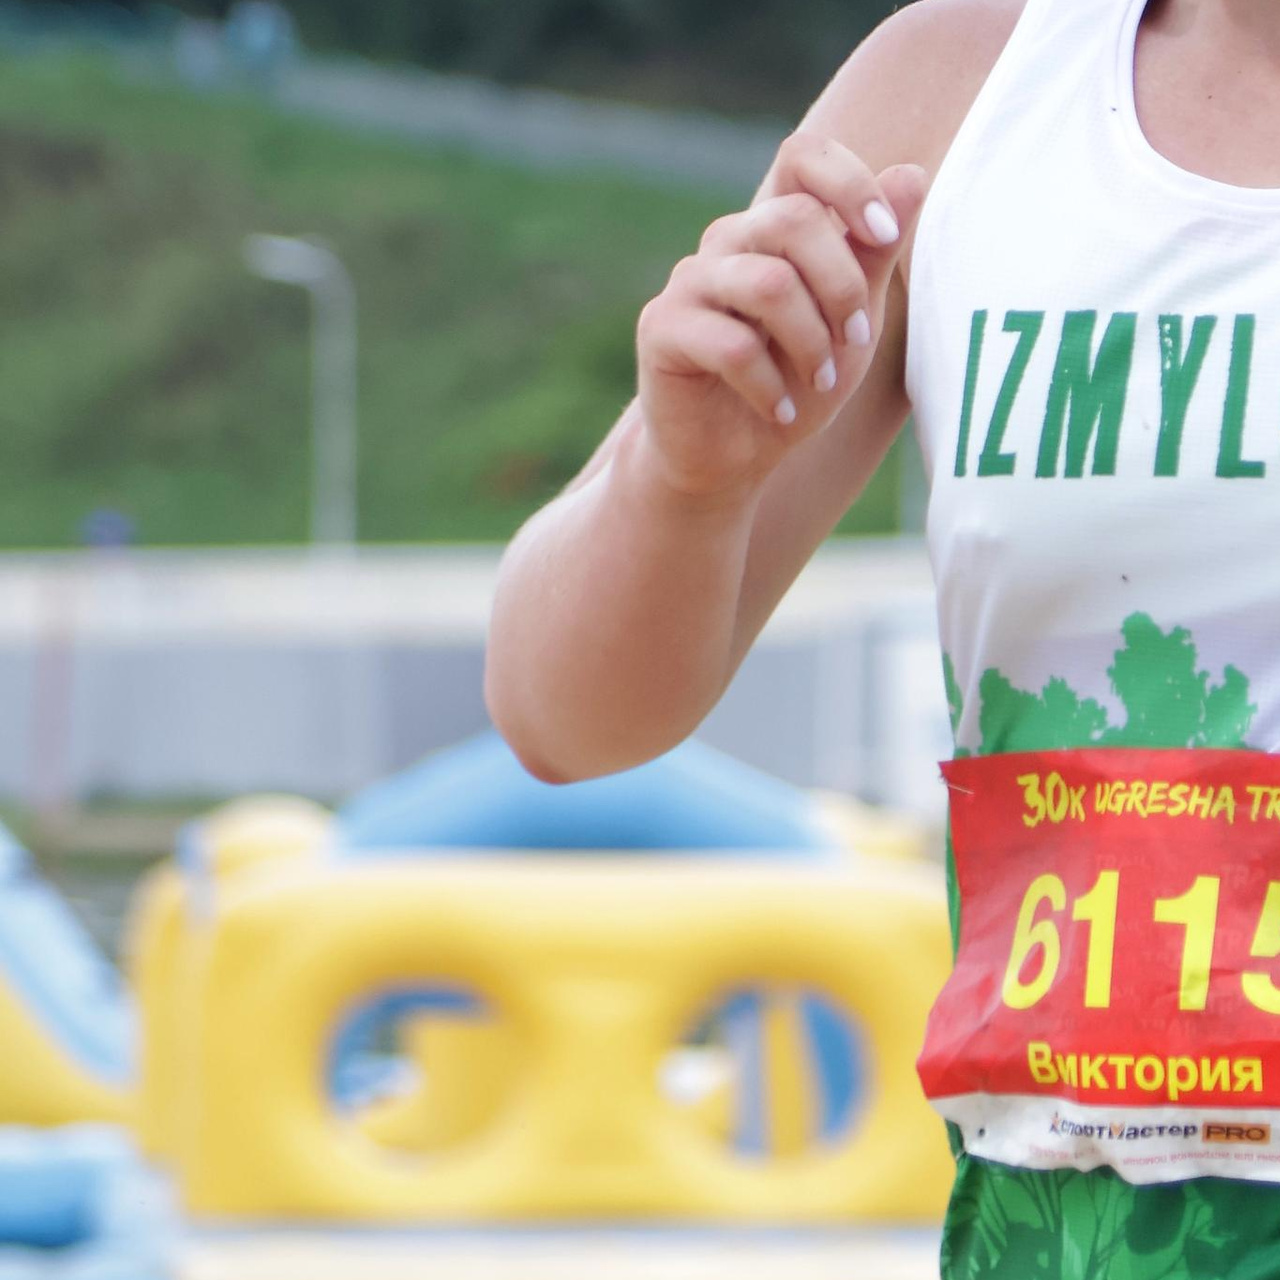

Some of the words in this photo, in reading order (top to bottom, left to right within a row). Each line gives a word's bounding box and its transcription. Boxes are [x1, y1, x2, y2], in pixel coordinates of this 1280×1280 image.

[1094, 780, 1236, 825] UGRESHA
[1027, 1041, 1264, 1101] Виктория
[1206, 1124, 1266, 1143] PRO
